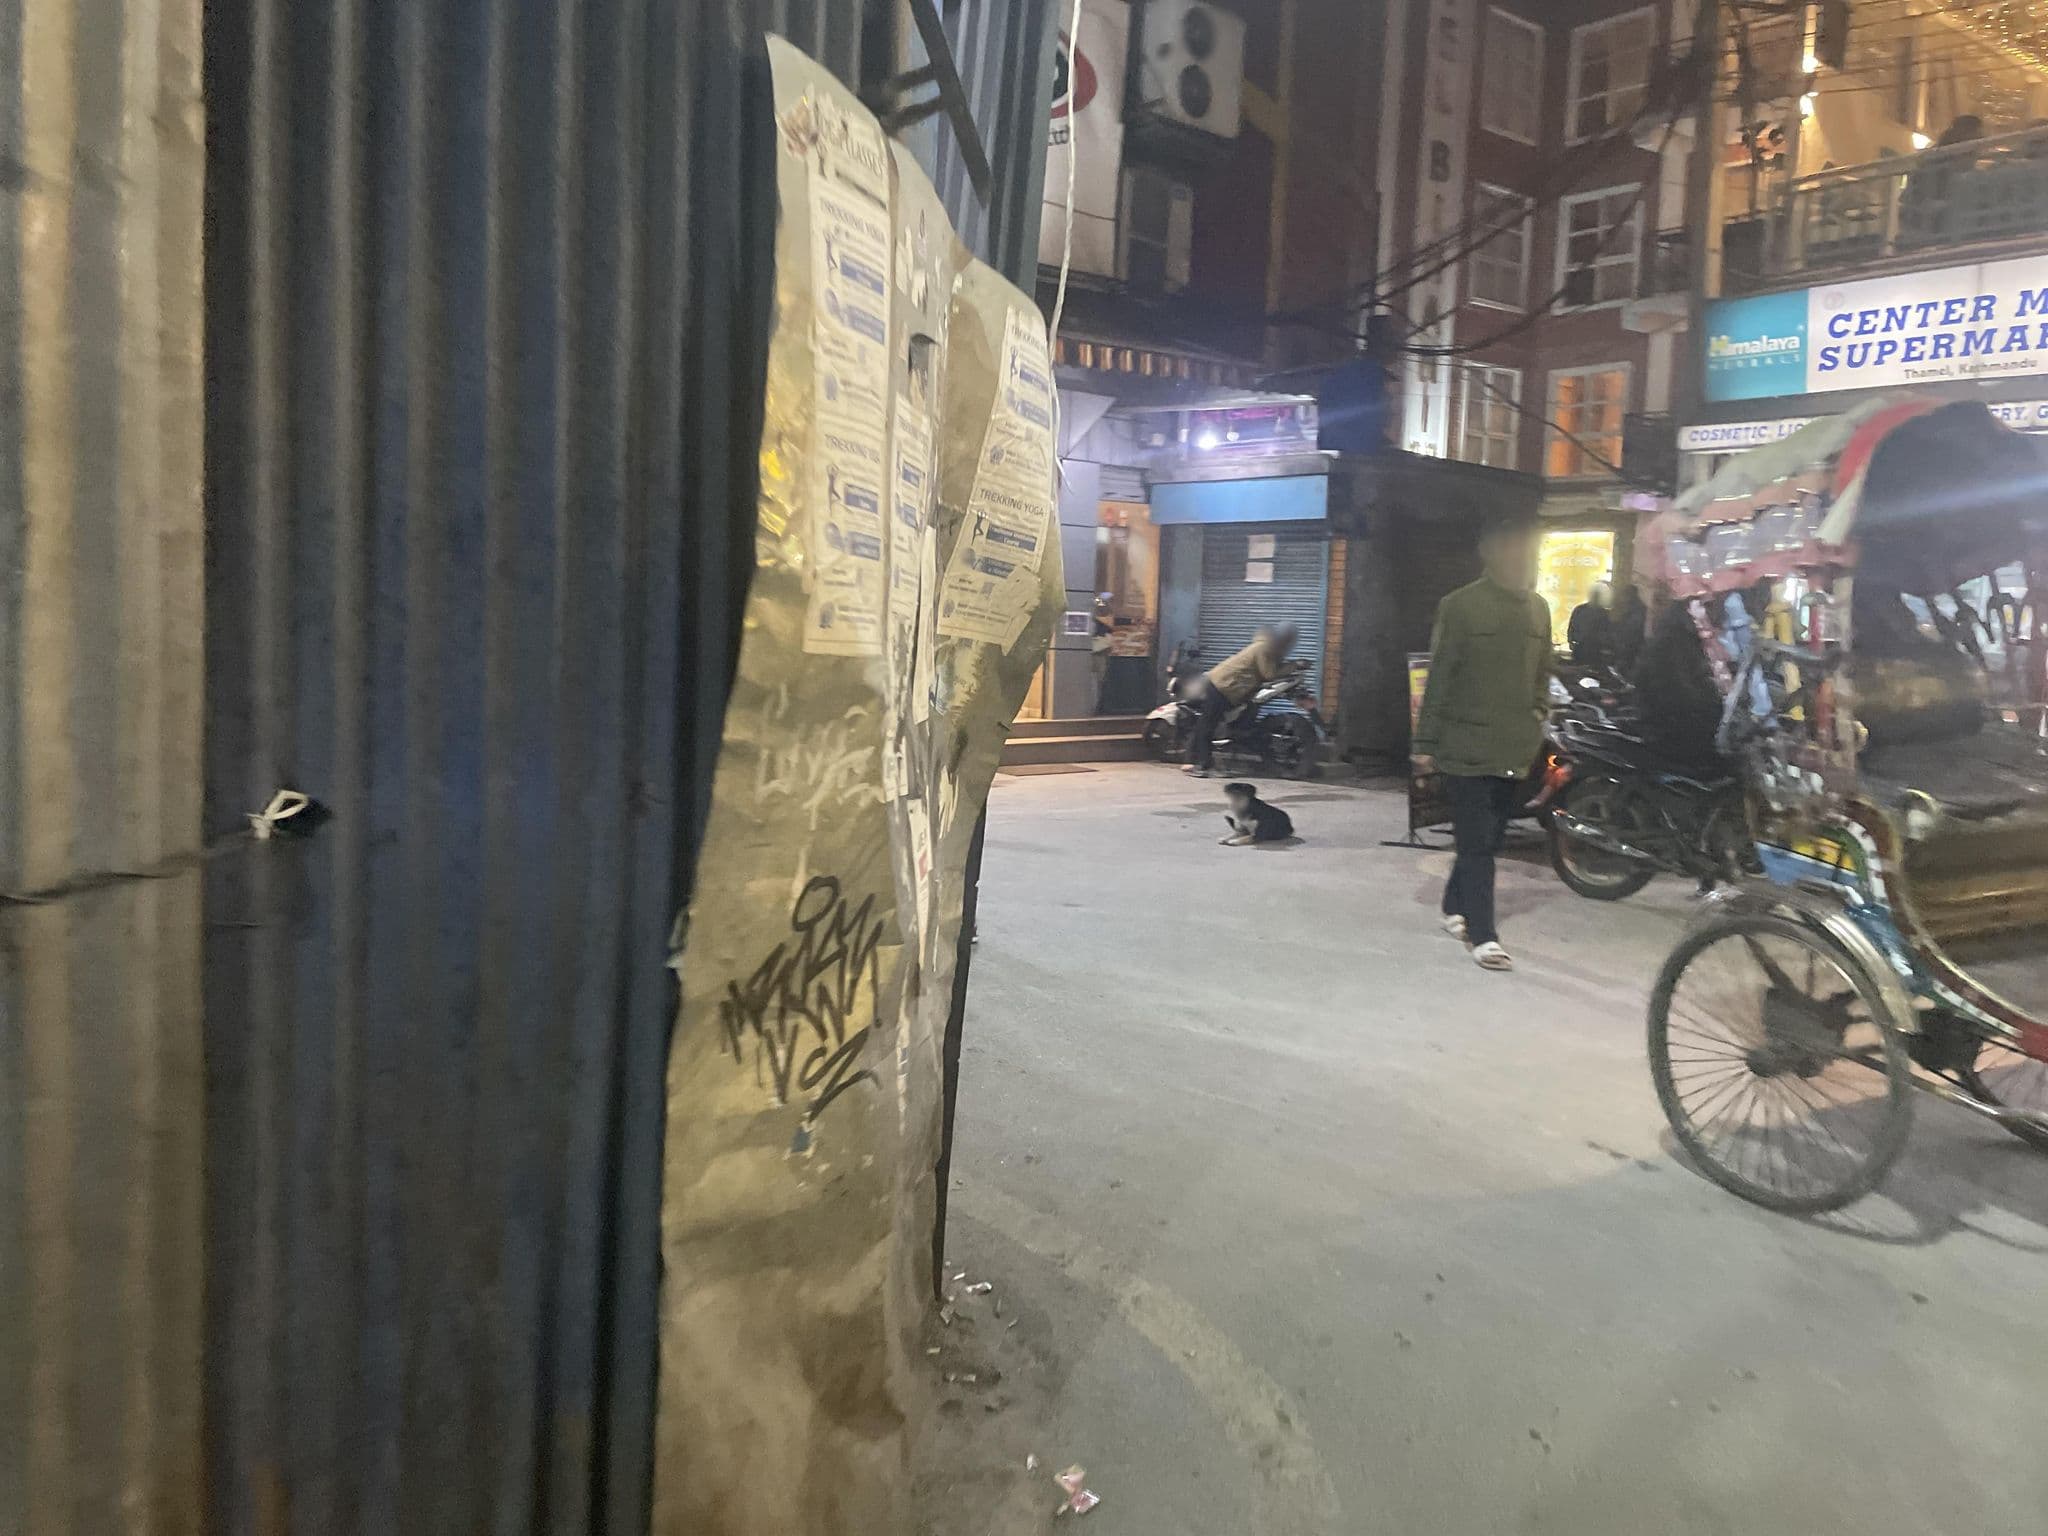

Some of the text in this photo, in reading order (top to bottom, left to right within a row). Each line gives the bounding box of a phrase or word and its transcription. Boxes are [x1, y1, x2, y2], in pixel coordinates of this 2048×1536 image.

[1827, 294, 1997, 339] CENTER
[979, 488, 1045, 518] TREKKING YOGA
